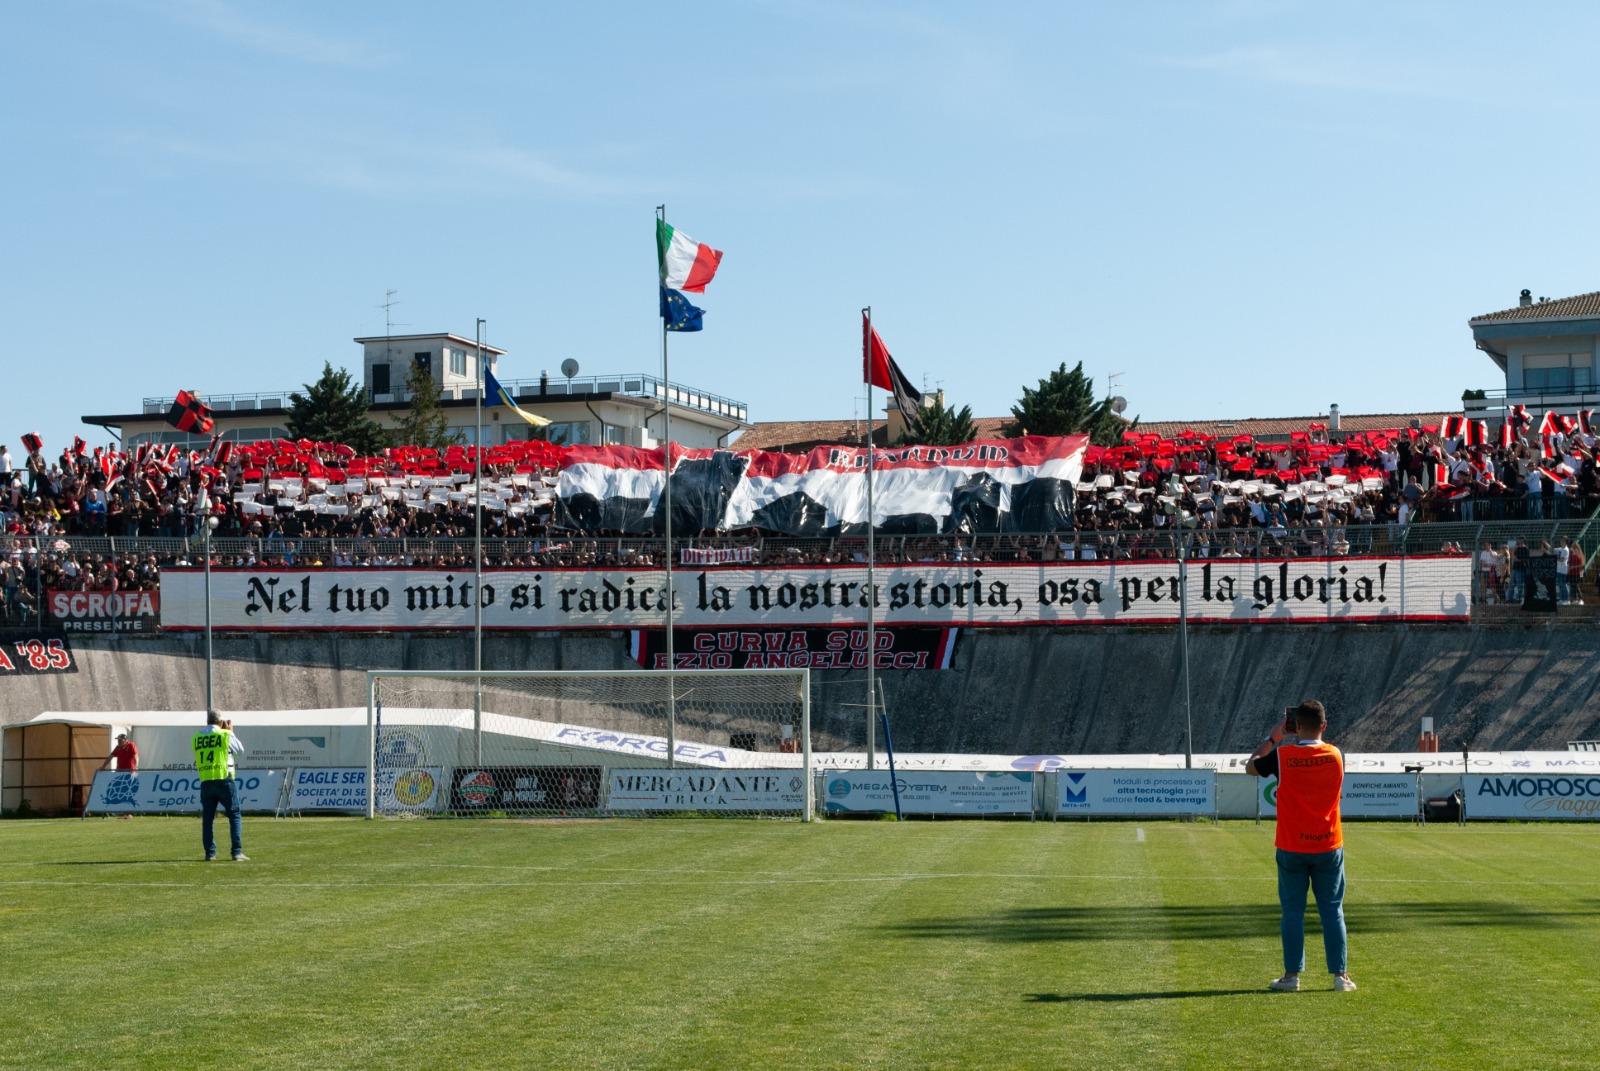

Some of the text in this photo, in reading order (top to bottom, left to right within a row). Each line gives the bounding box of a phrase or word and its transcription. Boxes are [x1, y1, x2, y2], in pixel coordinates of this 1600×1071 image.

[682, 548, 750, 563] DIFFIDATI
[244, 561, 1388, 616] Nel tuo mito si radica la nostra storia, osa per la gloria!
[54, 593, 155, 618] SCROFA
[63, 621, 142, 631] PRESENTE
[694, 631, 894, 652] CURVA SUD
[13, 638, 71, 670] '85
[653, 650, 929, 669] EZIO ANGELUCCI
[194, 735, 222, 751] LEGEA
[200, 750, 214, 764] 14
[1286, 755, 1336, 767] Kappa
[298, 772, 339, 784] EAGLE
[614, 776, 780, 792] MERCADANTE
[1153, 779, 1193, 787] processo
[296, 788, 340, 797] SOCIETA'
[342, 788, 352, 796] DI
[1137, 787, 1184, 796] tecnologia
[1185, 788, 1201, 796] per
[159, 795, 196, 808] sport
[316, 798, 367, 806] LANCIANO
[662, 795, 728, 804] TRUCK
[1164, 796, 1207, 805] beverage
